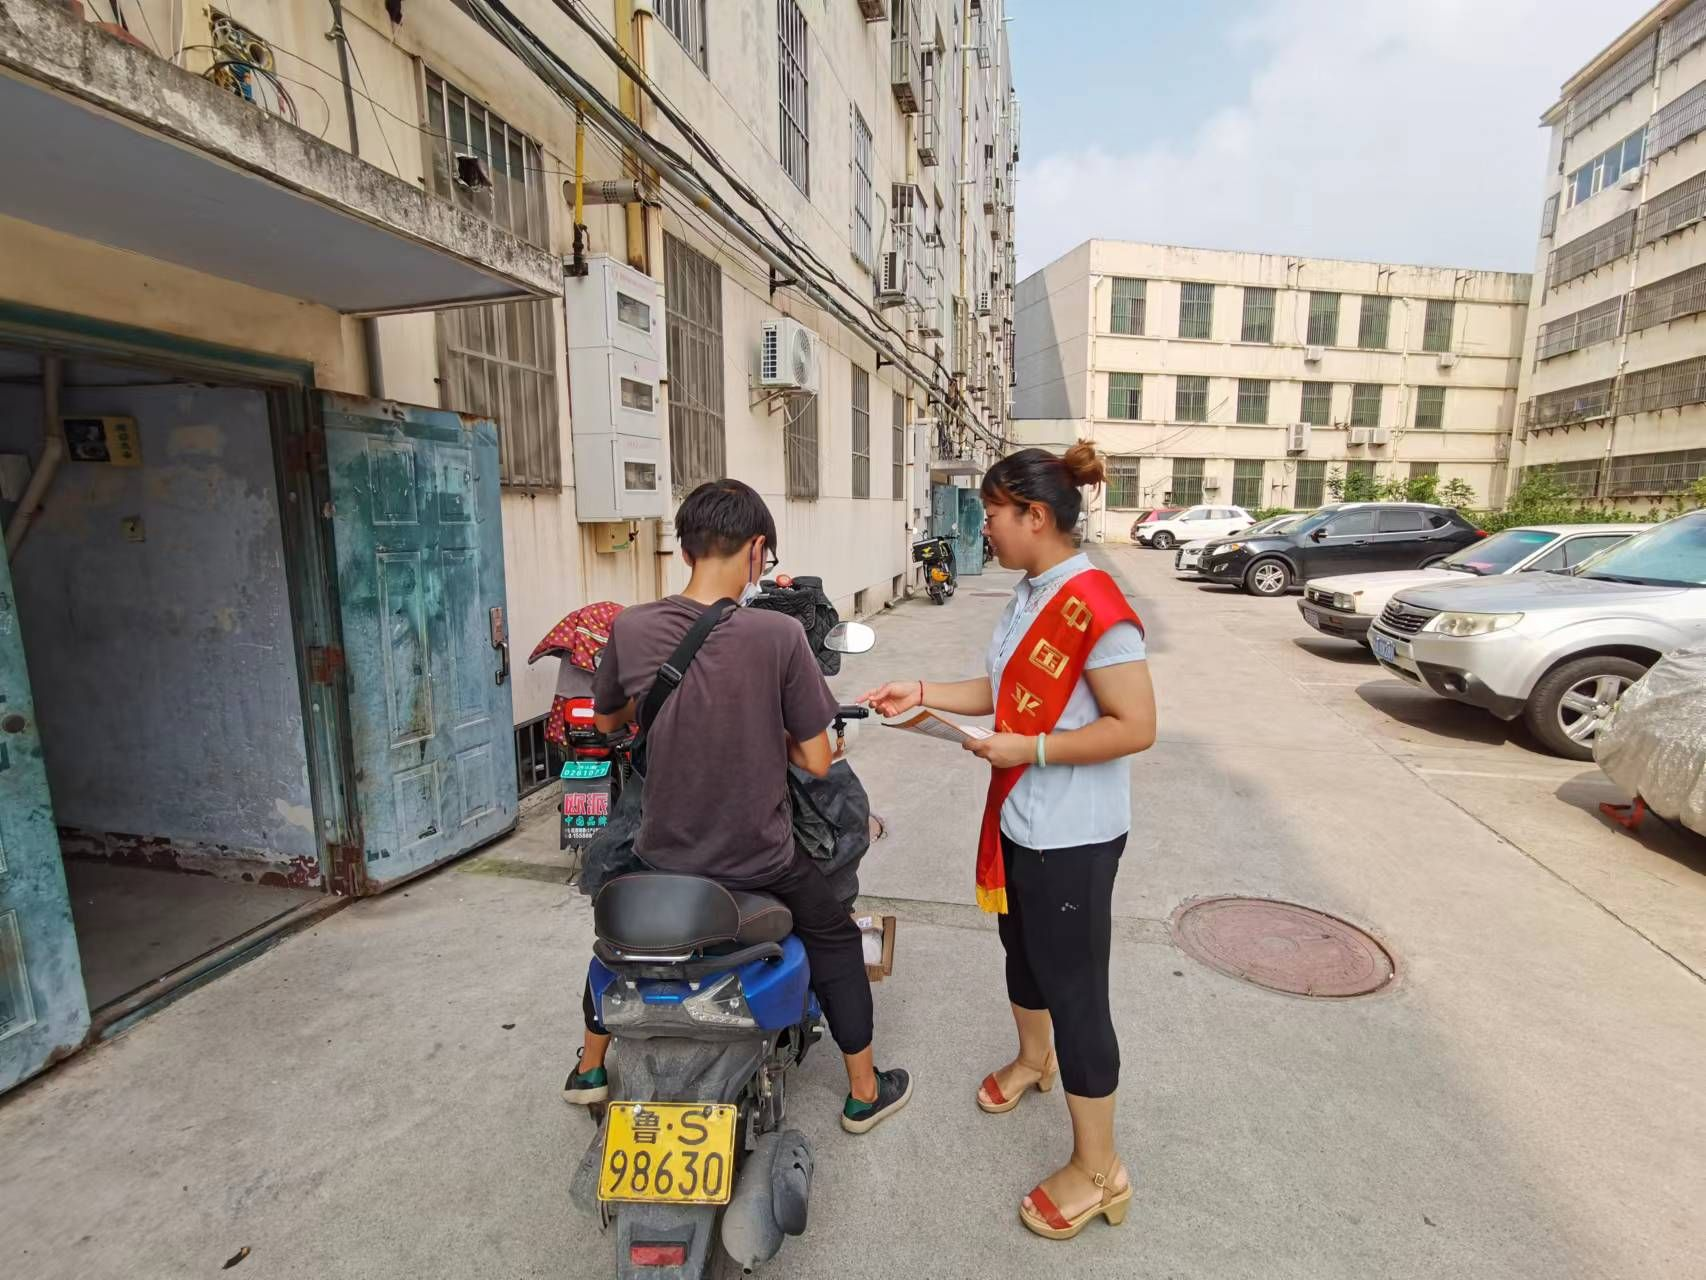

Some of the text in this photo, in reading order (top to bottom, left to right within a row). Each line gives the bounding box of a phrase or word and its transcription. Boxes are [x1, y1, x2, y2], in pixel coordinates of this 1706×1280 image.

[1001, 596, 1093, 733] 中国平
[610, 1149, 724, 1196] 98630
